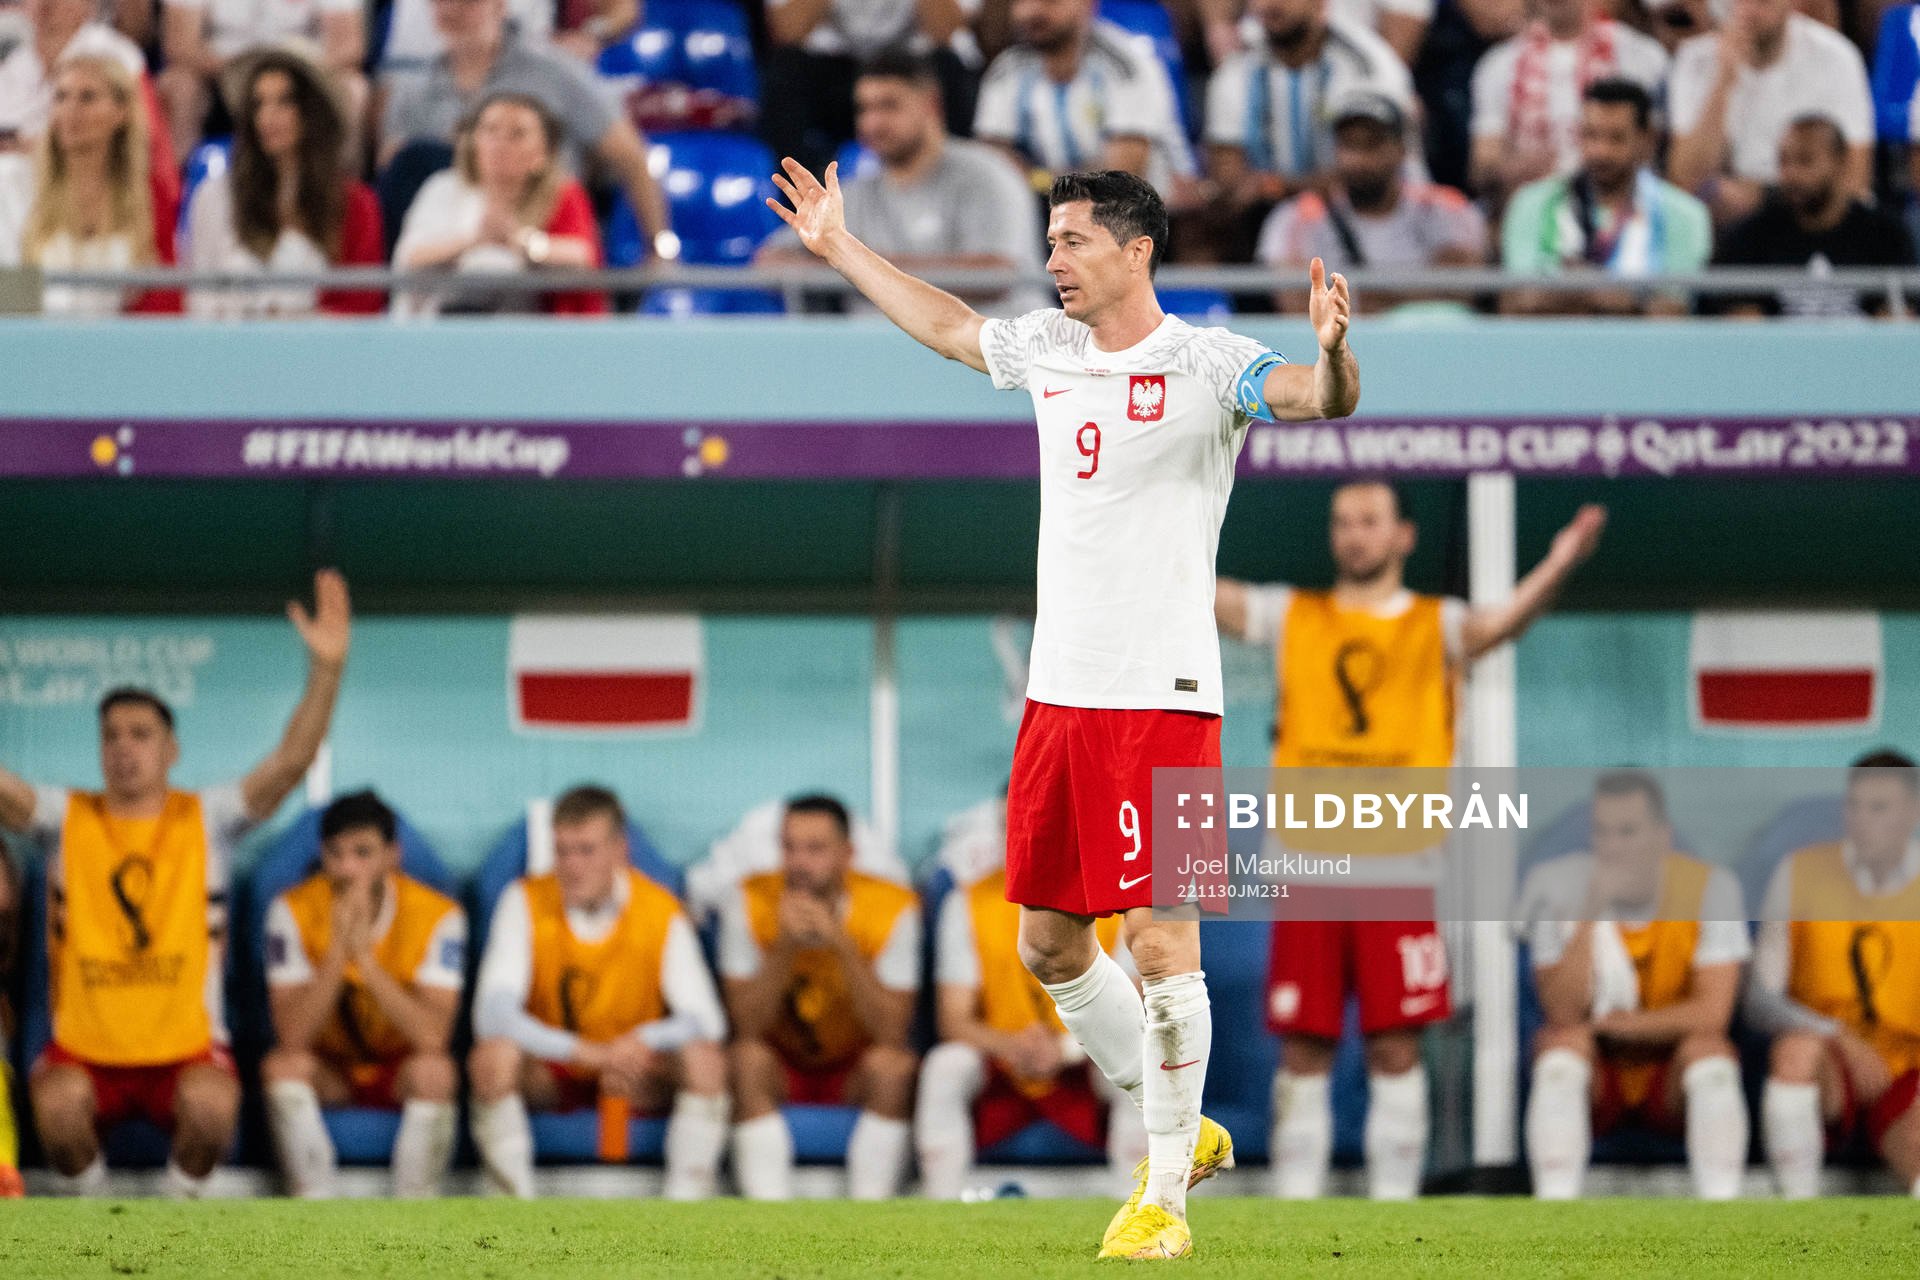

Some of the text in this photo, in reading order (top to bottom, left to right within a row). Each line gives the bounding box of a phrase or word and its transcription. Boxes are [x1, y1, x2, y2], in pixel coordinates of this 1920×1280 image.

[243, 429, 569, 476] #FIFAWorldCup
[1076, 421, 1101, 480] 9
[1251, 424, 1347, 470] FIFA
[1349, 424, 1500, 470] WORLD
[1507, 424, 1591, 470] CUP
[1118, 799, 1142, 862] 9
[1396, 934, 1446, 991] 10
